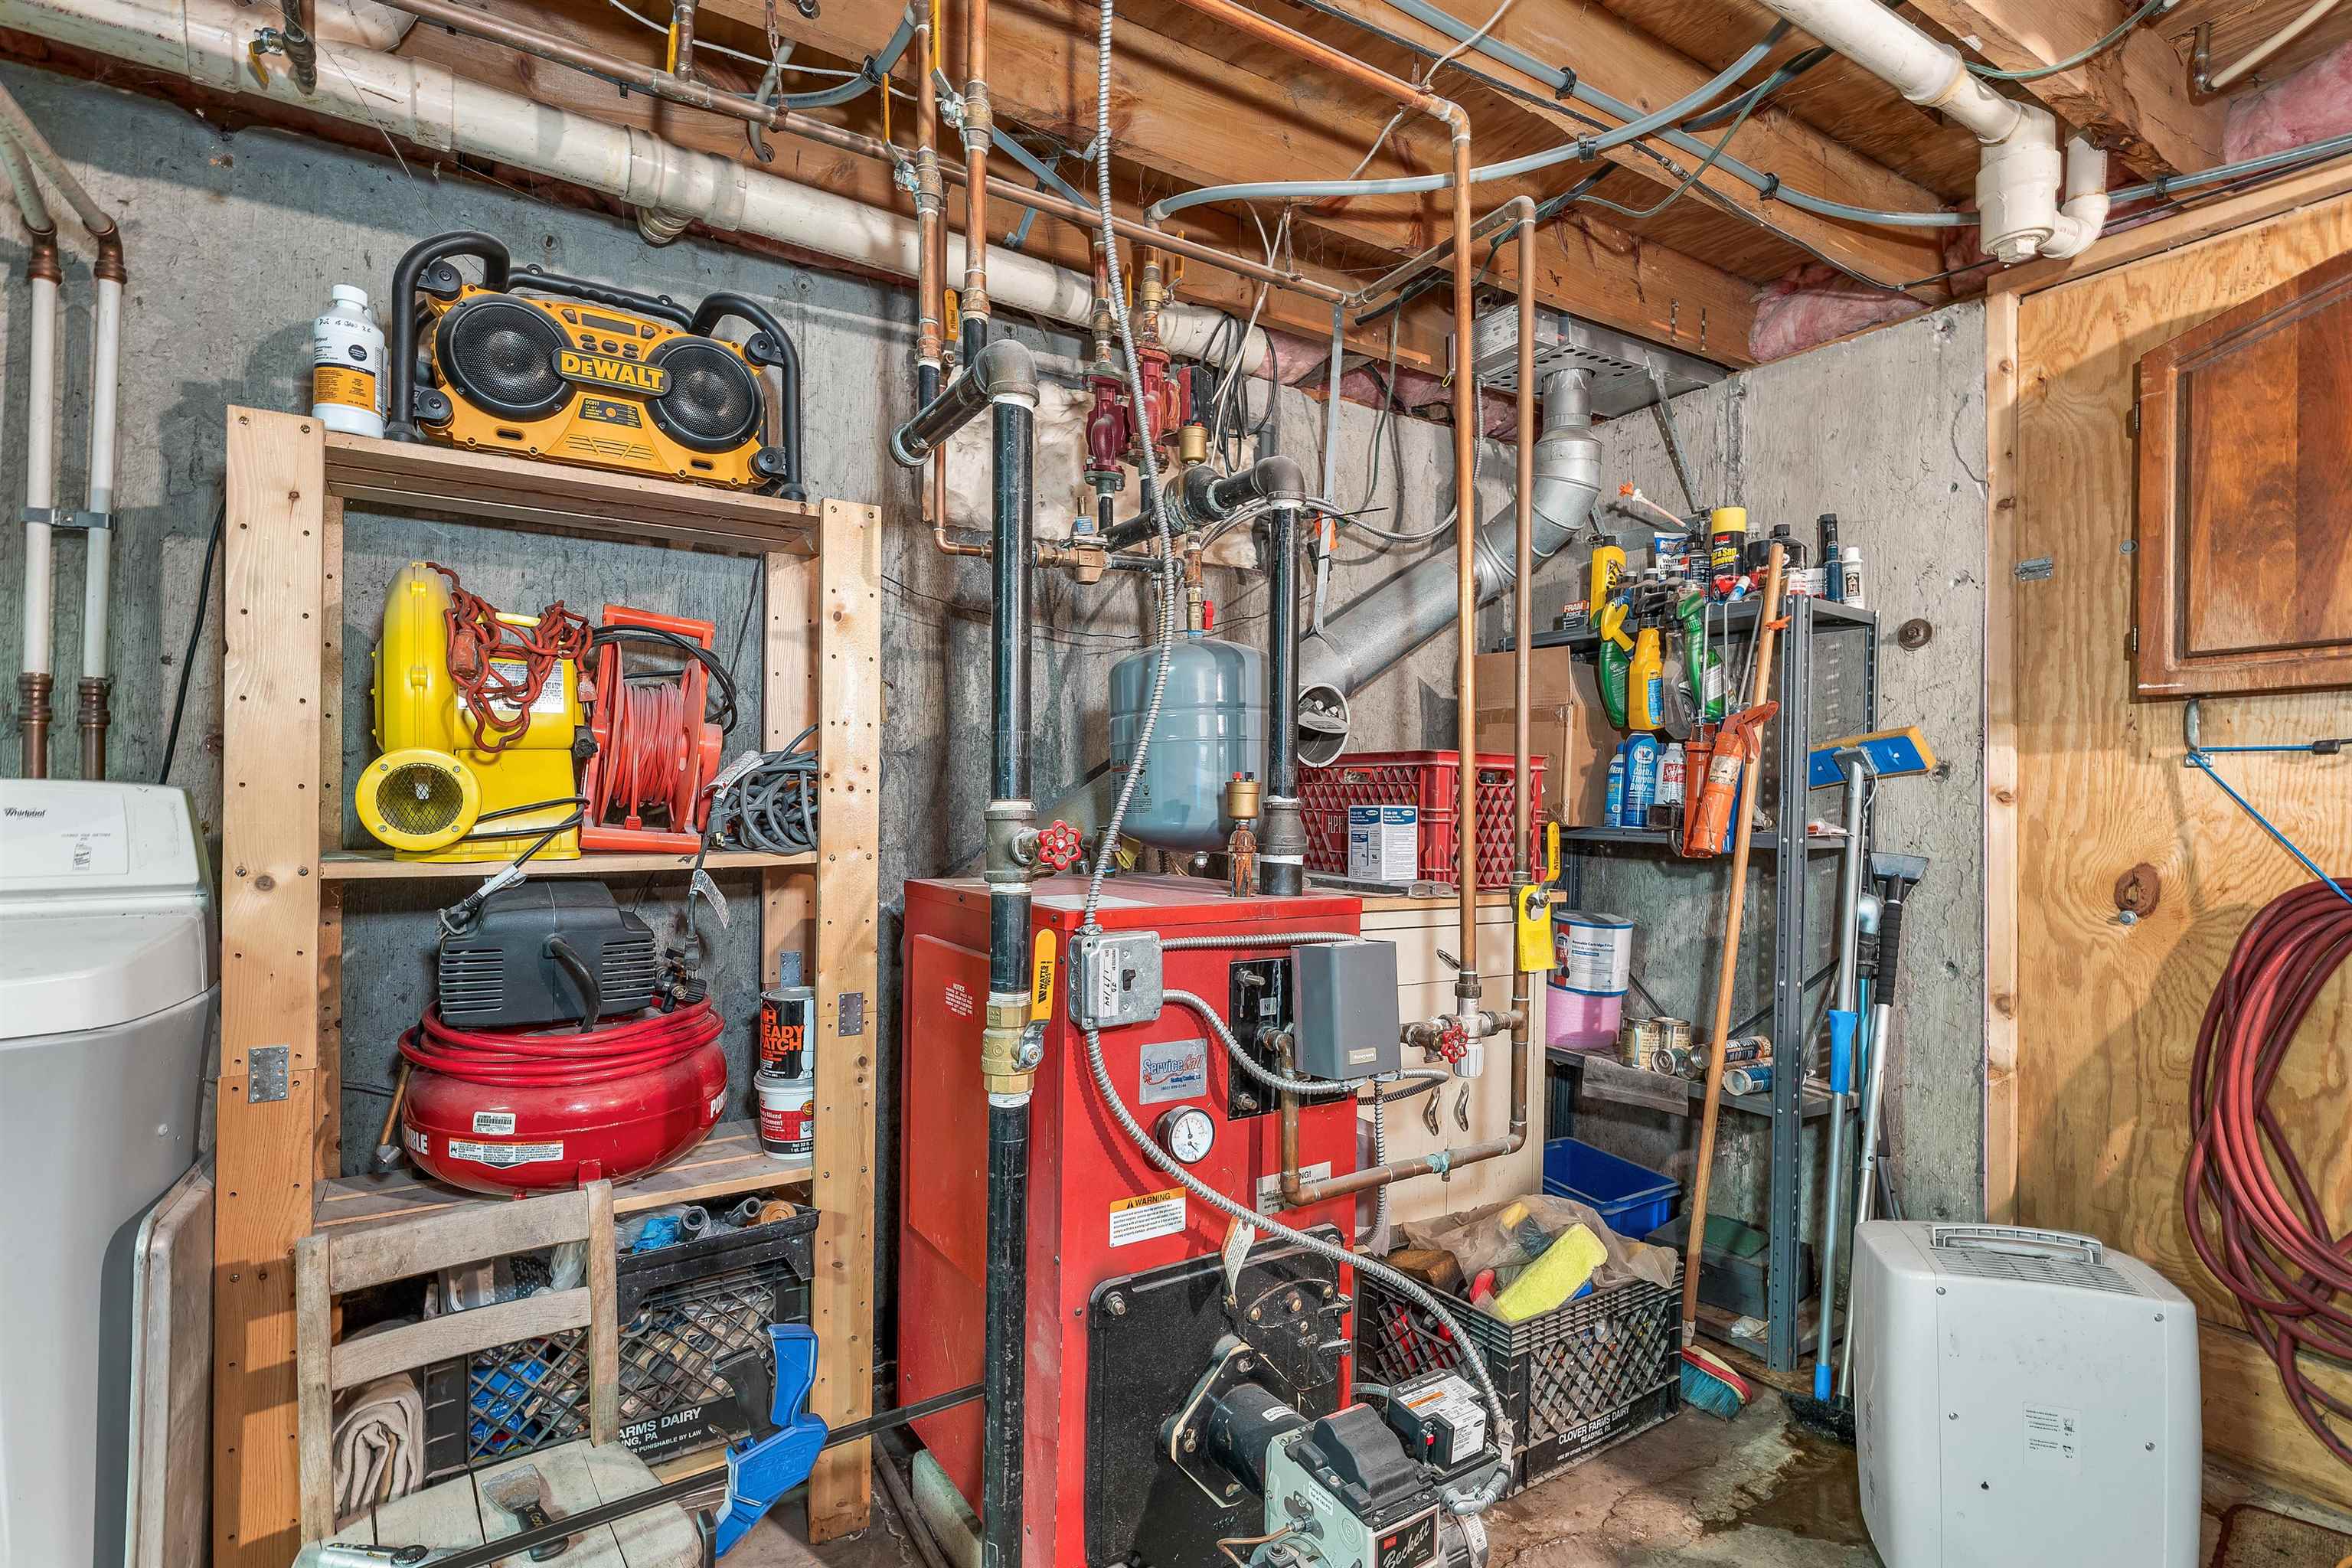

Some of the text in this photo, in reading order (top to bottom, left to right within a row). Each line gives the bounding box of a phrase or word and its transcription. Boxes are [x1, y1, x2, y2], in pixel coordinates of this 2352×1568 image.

[1722, 547, 1736, 557] Sap
[1563, 600, 1581, 612] FRAM
[1629, 783, 1647, 792] Body
[4, 807, 46, 818] Whirlpool
[1135, 1192, 1171, 1207] WARNING
[661, 1406, 702, 1429] DAIRY
[645, 1431, 658, 1442] PA
[1558, 1425, 1588, 1446] CLOVER
[1588, 1414, 1611, 1432] FARMS
[639, 1434, 678, 1453] PUNISHABLE
[688, 1429, 702, 1439] LAW
[1383, 1519, 1430, 1568] Beckett
